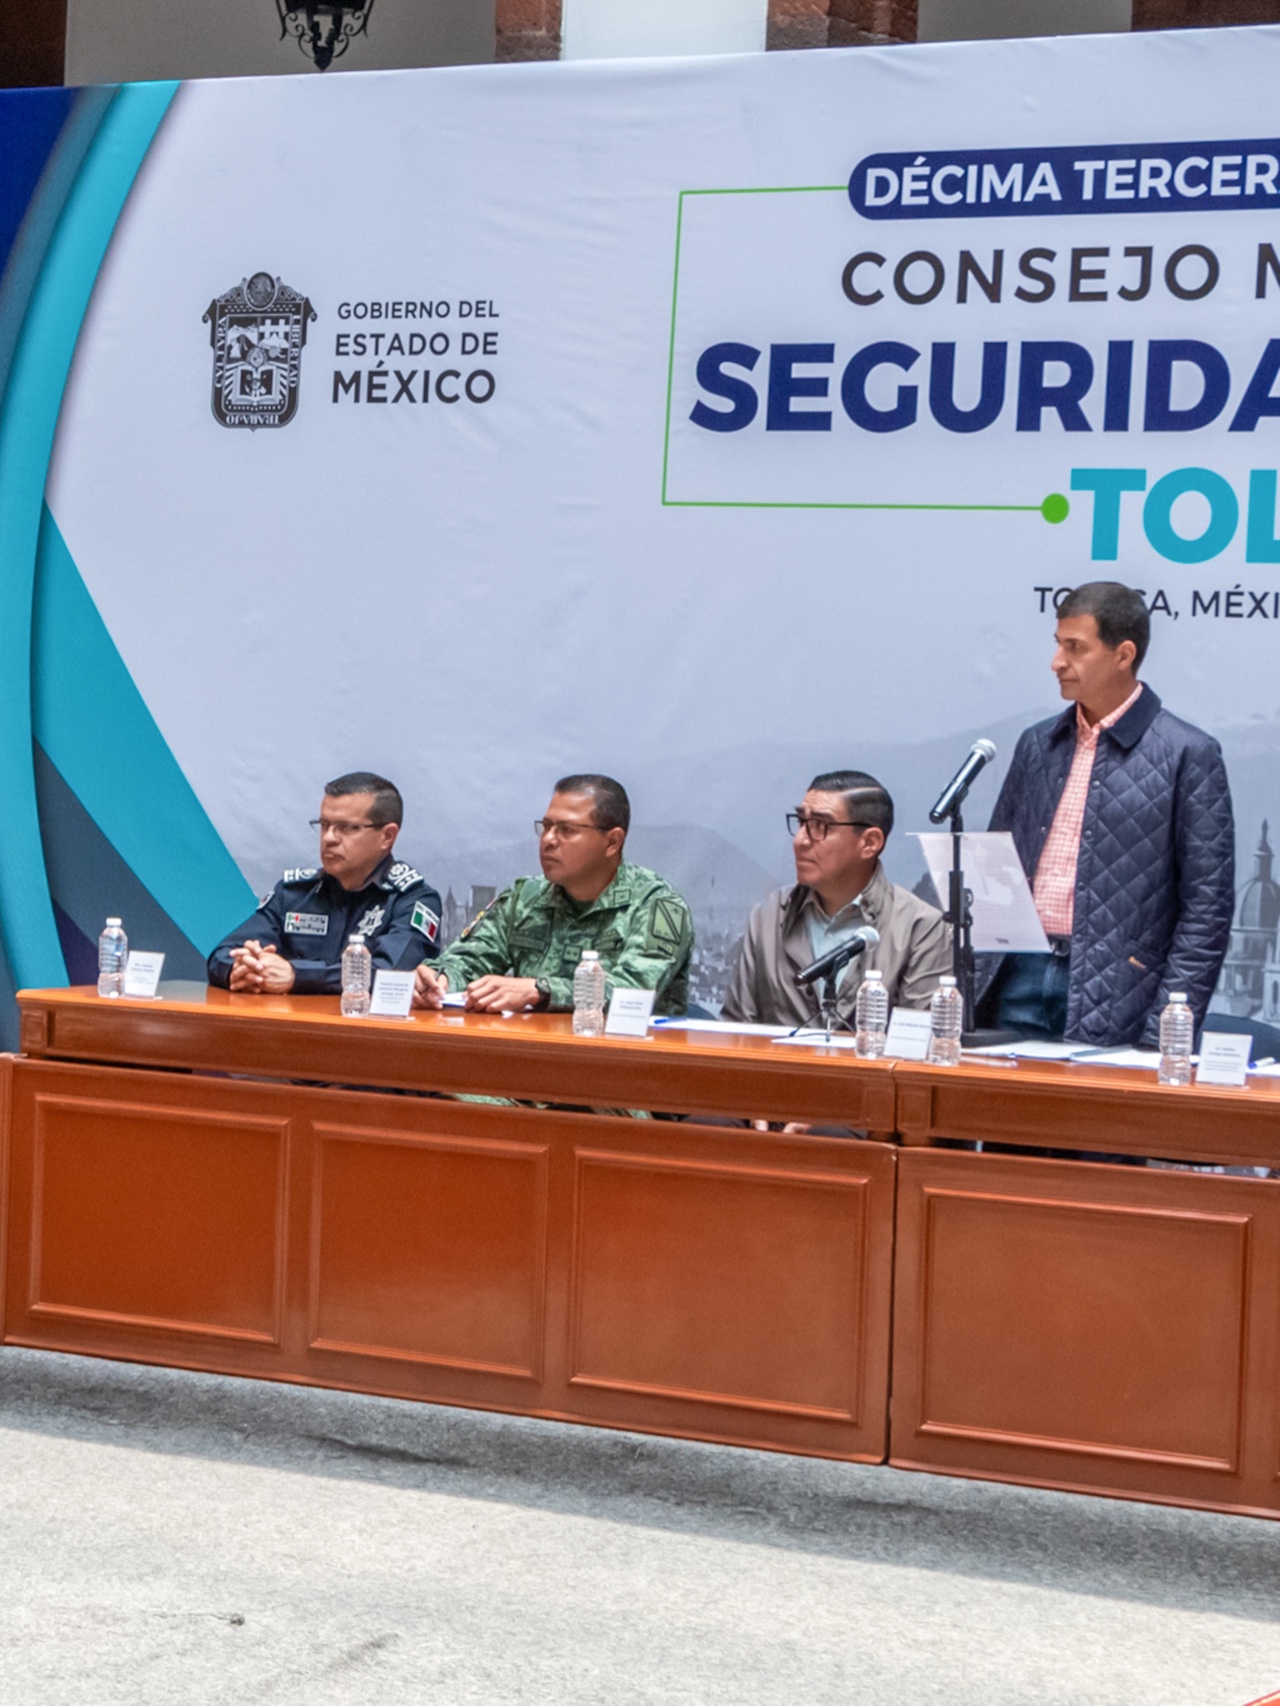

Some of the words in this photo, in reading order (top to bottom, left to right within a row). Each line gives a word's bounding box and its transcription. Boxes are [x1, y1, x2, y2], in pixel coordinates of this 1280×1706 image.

[864, 156, 1062, 206] DÉCIMA
[1074, 153, 1280, 201] TERCER
[842, 244, 1220, 306] CONSEJO
[337, 301, 451, 319] GOBIERNO
[458, 300, 500, 318] DEL
[335, 332, 450, 356] ESTADO
[460, 332, 499, 356] DE
[332, 360, 496, 404] MÉXICO
